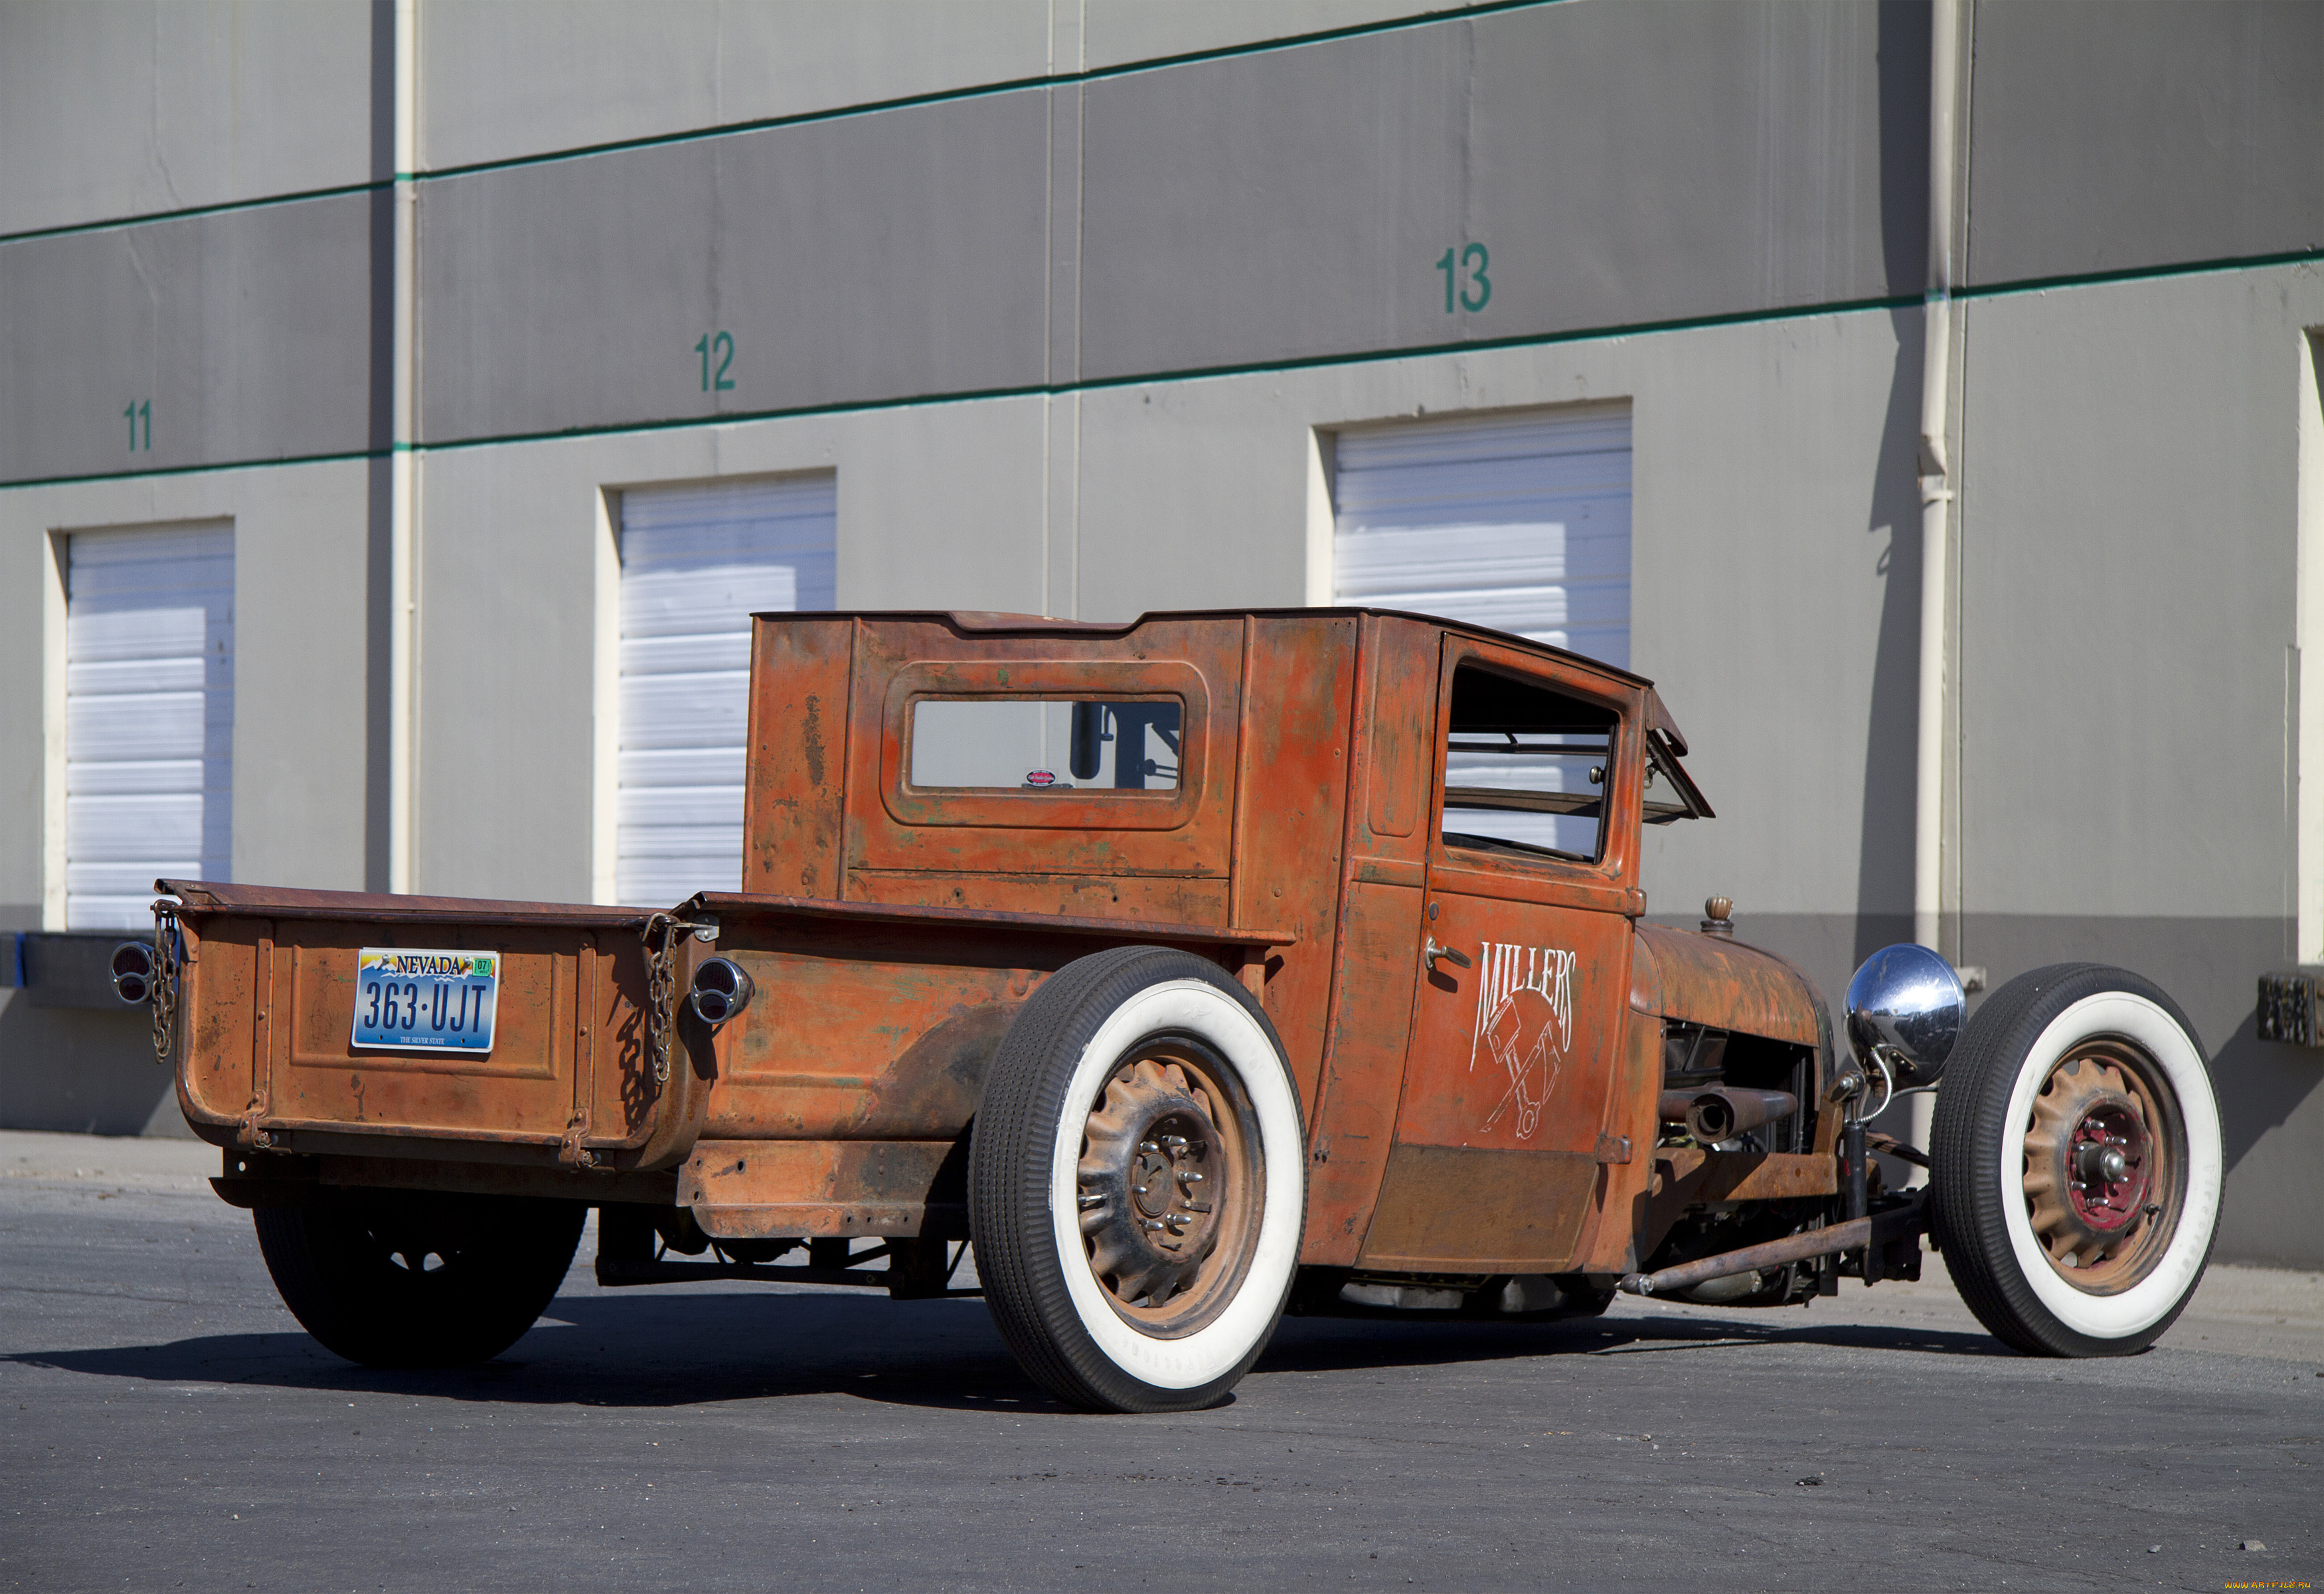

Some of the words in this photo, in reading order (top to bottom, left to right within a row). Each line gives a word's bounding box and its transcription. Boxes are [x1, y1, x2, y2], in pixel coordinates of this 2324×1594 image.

[1436, 242, 1491, 313] 13
[695, 331, 735, 392] 12
[123, 399, 151, 452] 11
[396, 956, 461, 975] NEVADA
[477, 960, 487, 970] 07
[1469, 942, 1576, 1072] MILLERS
